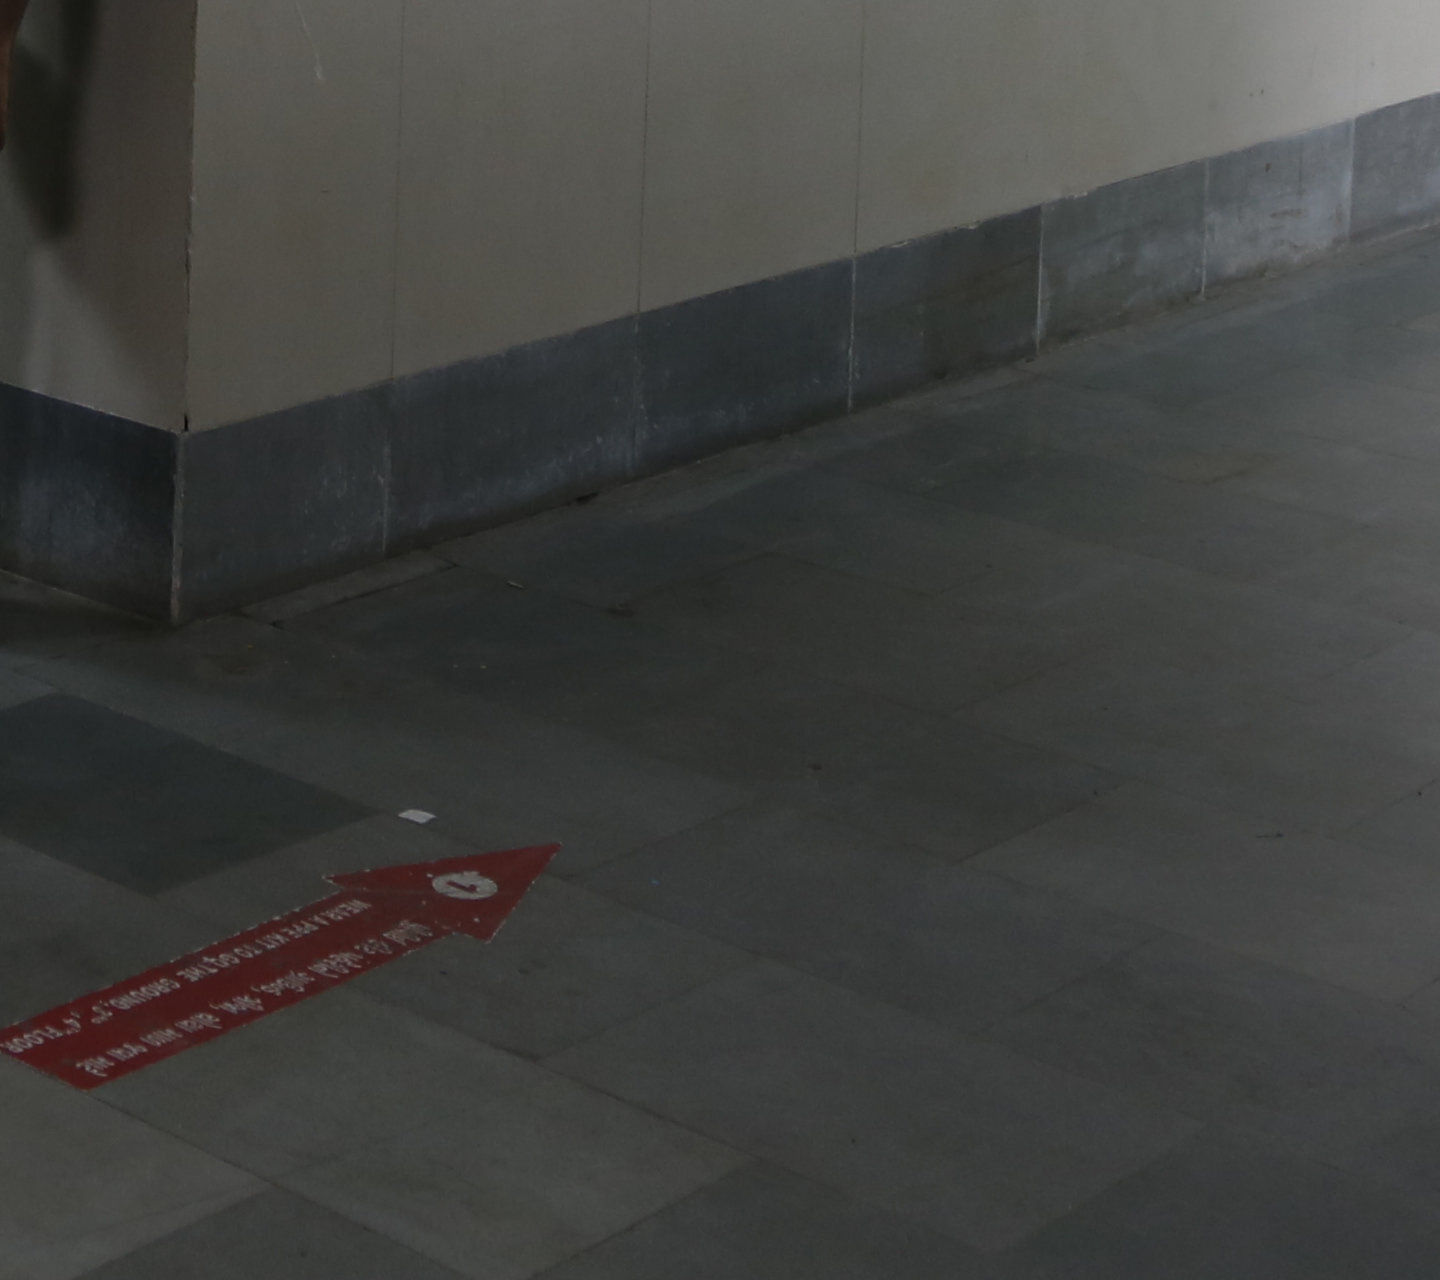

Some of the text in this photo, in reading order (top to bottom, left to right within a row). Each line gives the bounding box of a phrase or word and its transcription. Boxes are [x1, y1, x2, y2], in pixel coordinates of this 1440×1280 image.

[320, 899, 369, 919] WEAR
[280, 920, 319, 938] PPE
[254, 933, 289, 949] KIT
[232, 945, 262, 957] TO
[175, 964, 218, 981] THE
[0, 1026, 62, 1053] FLOOR
